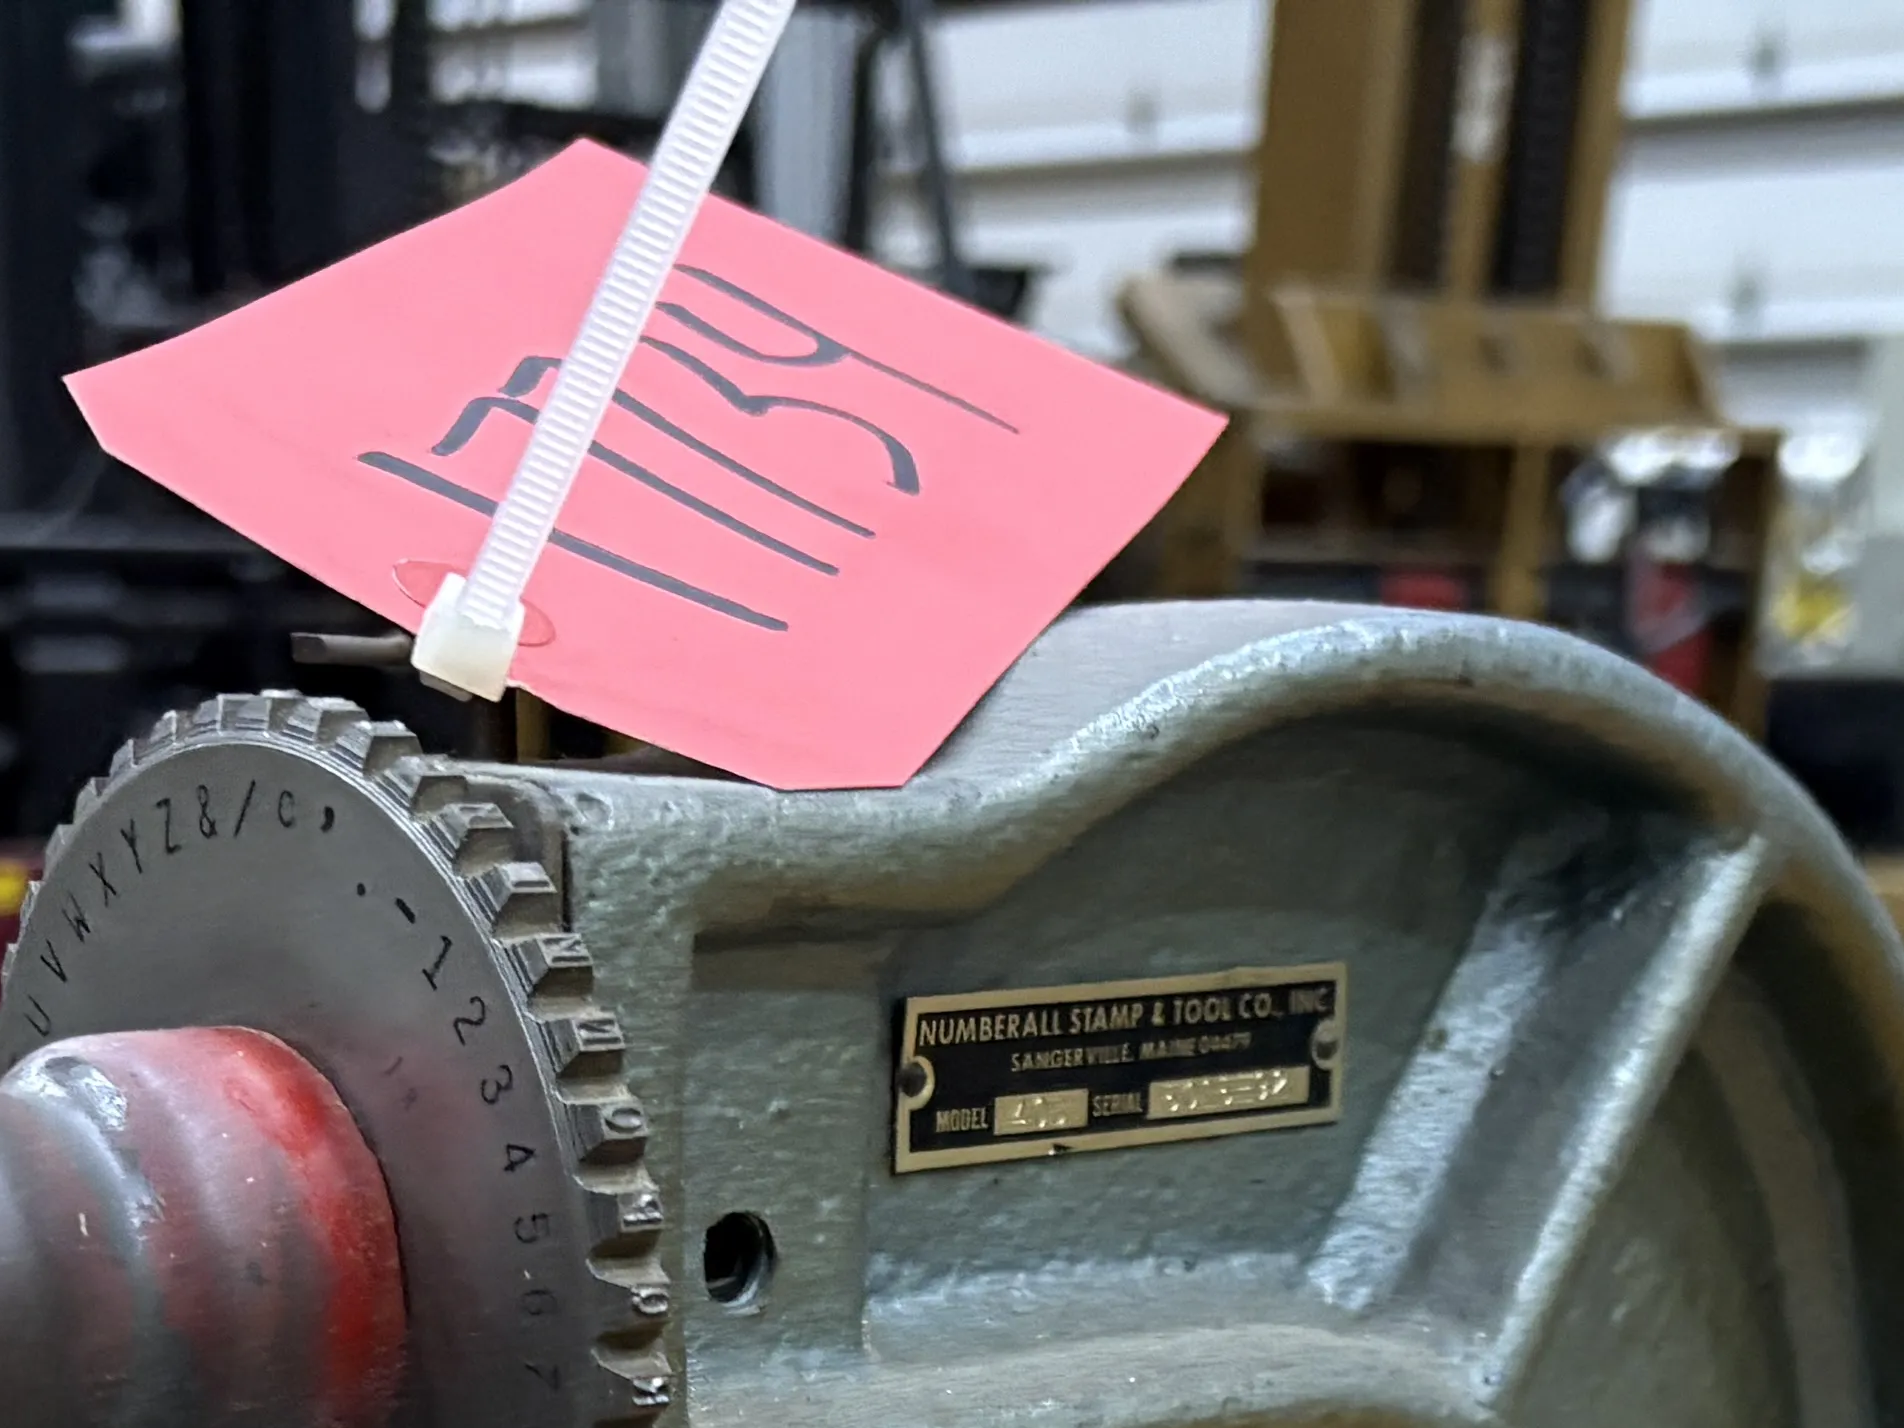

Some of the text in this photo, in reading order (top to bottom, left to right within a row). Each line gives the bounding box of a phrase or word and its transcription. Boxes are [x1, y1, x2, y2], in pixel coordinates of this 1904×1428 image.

[919, 1009, 1063, 1046] NUMBERALL
[1069, 1002, 1144, 1035] STAMP
[1151, 1001, 1166, 1026] &
[1173, 997, 1232, 1026] TOOL
[936, 1107, 989, 1133] MODEL
[1093, 1092, 1143, 1117] SERIAL
